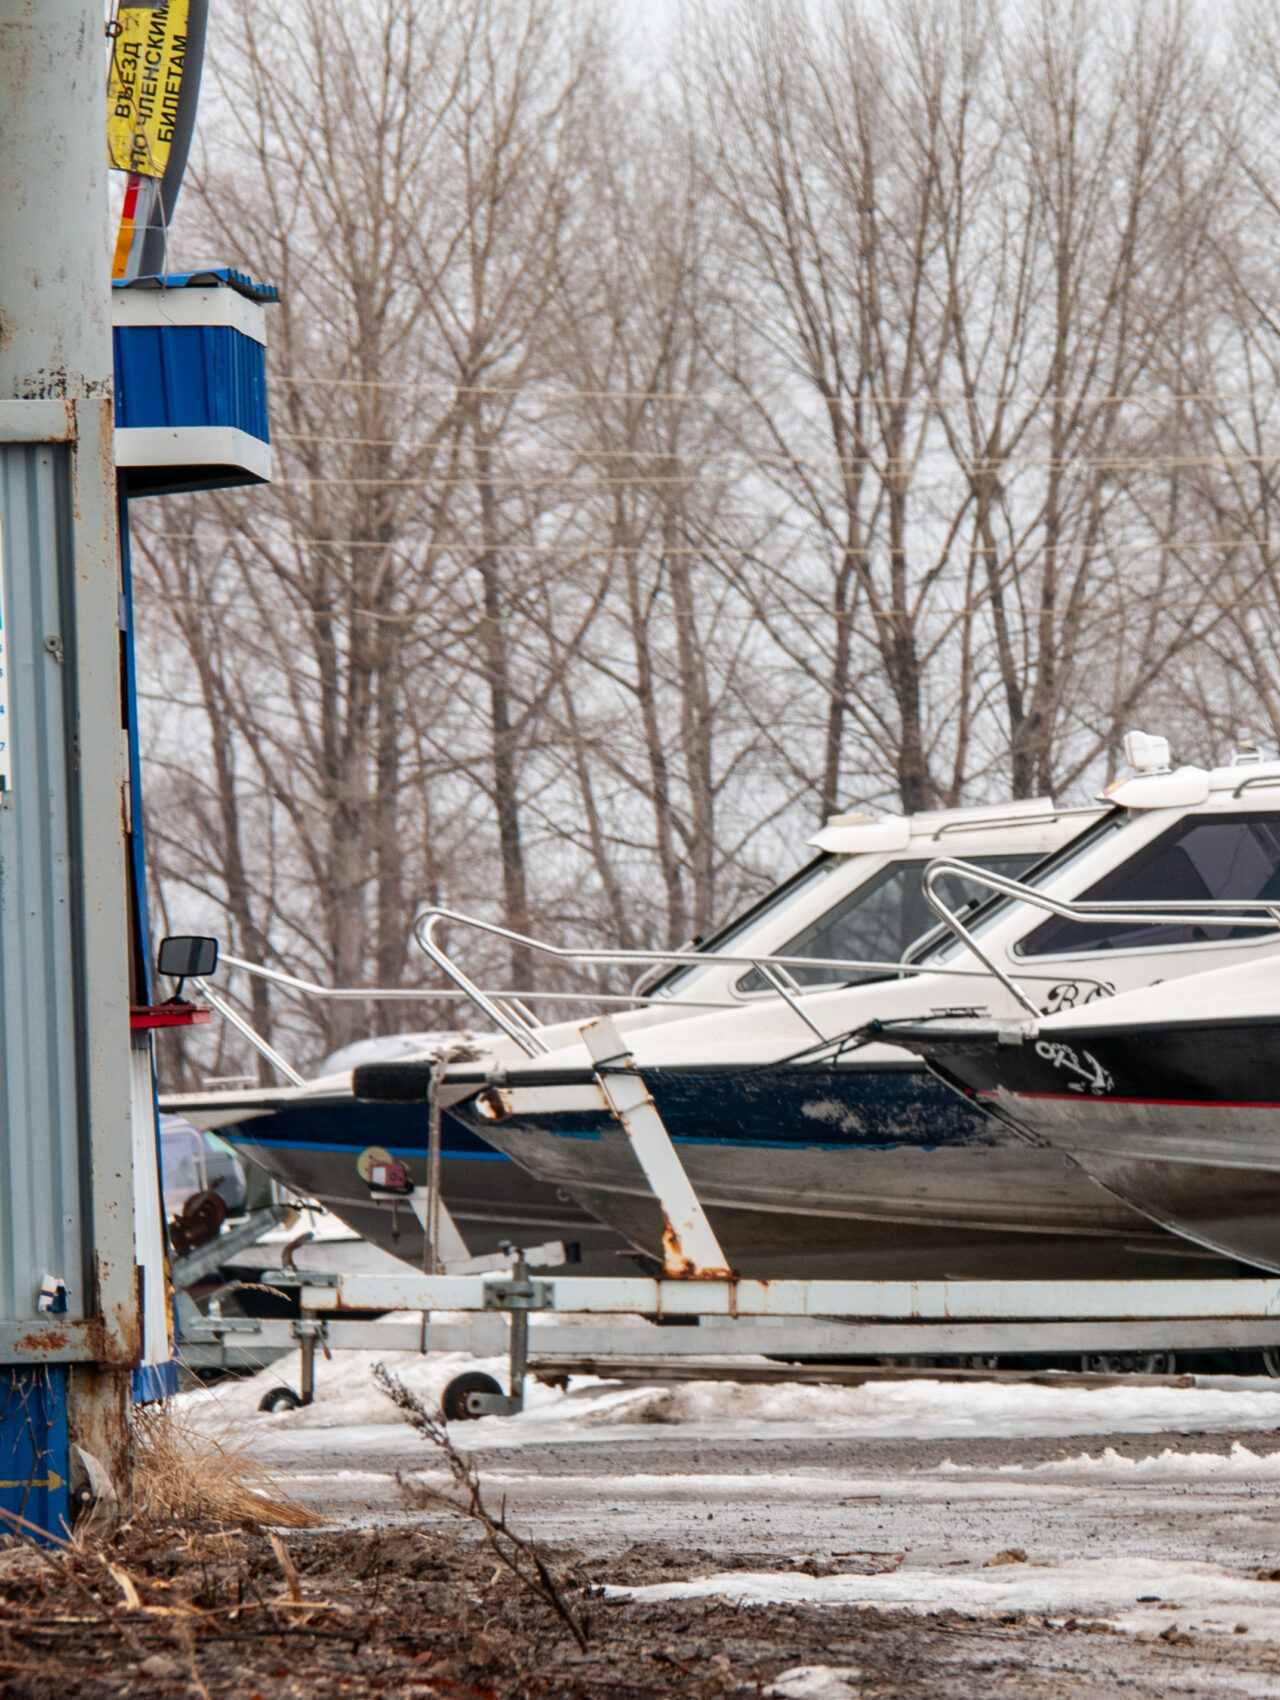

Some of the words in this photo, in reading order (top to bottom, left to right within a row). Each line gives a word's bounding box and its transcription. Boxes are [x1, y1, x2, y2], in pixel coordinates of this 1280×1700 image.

[114, 42, 142, 119] ВЪЕЗД
[157, 34, 188, 144] БИЛЕТАМ
[129, 133, 148, 168] ПО
